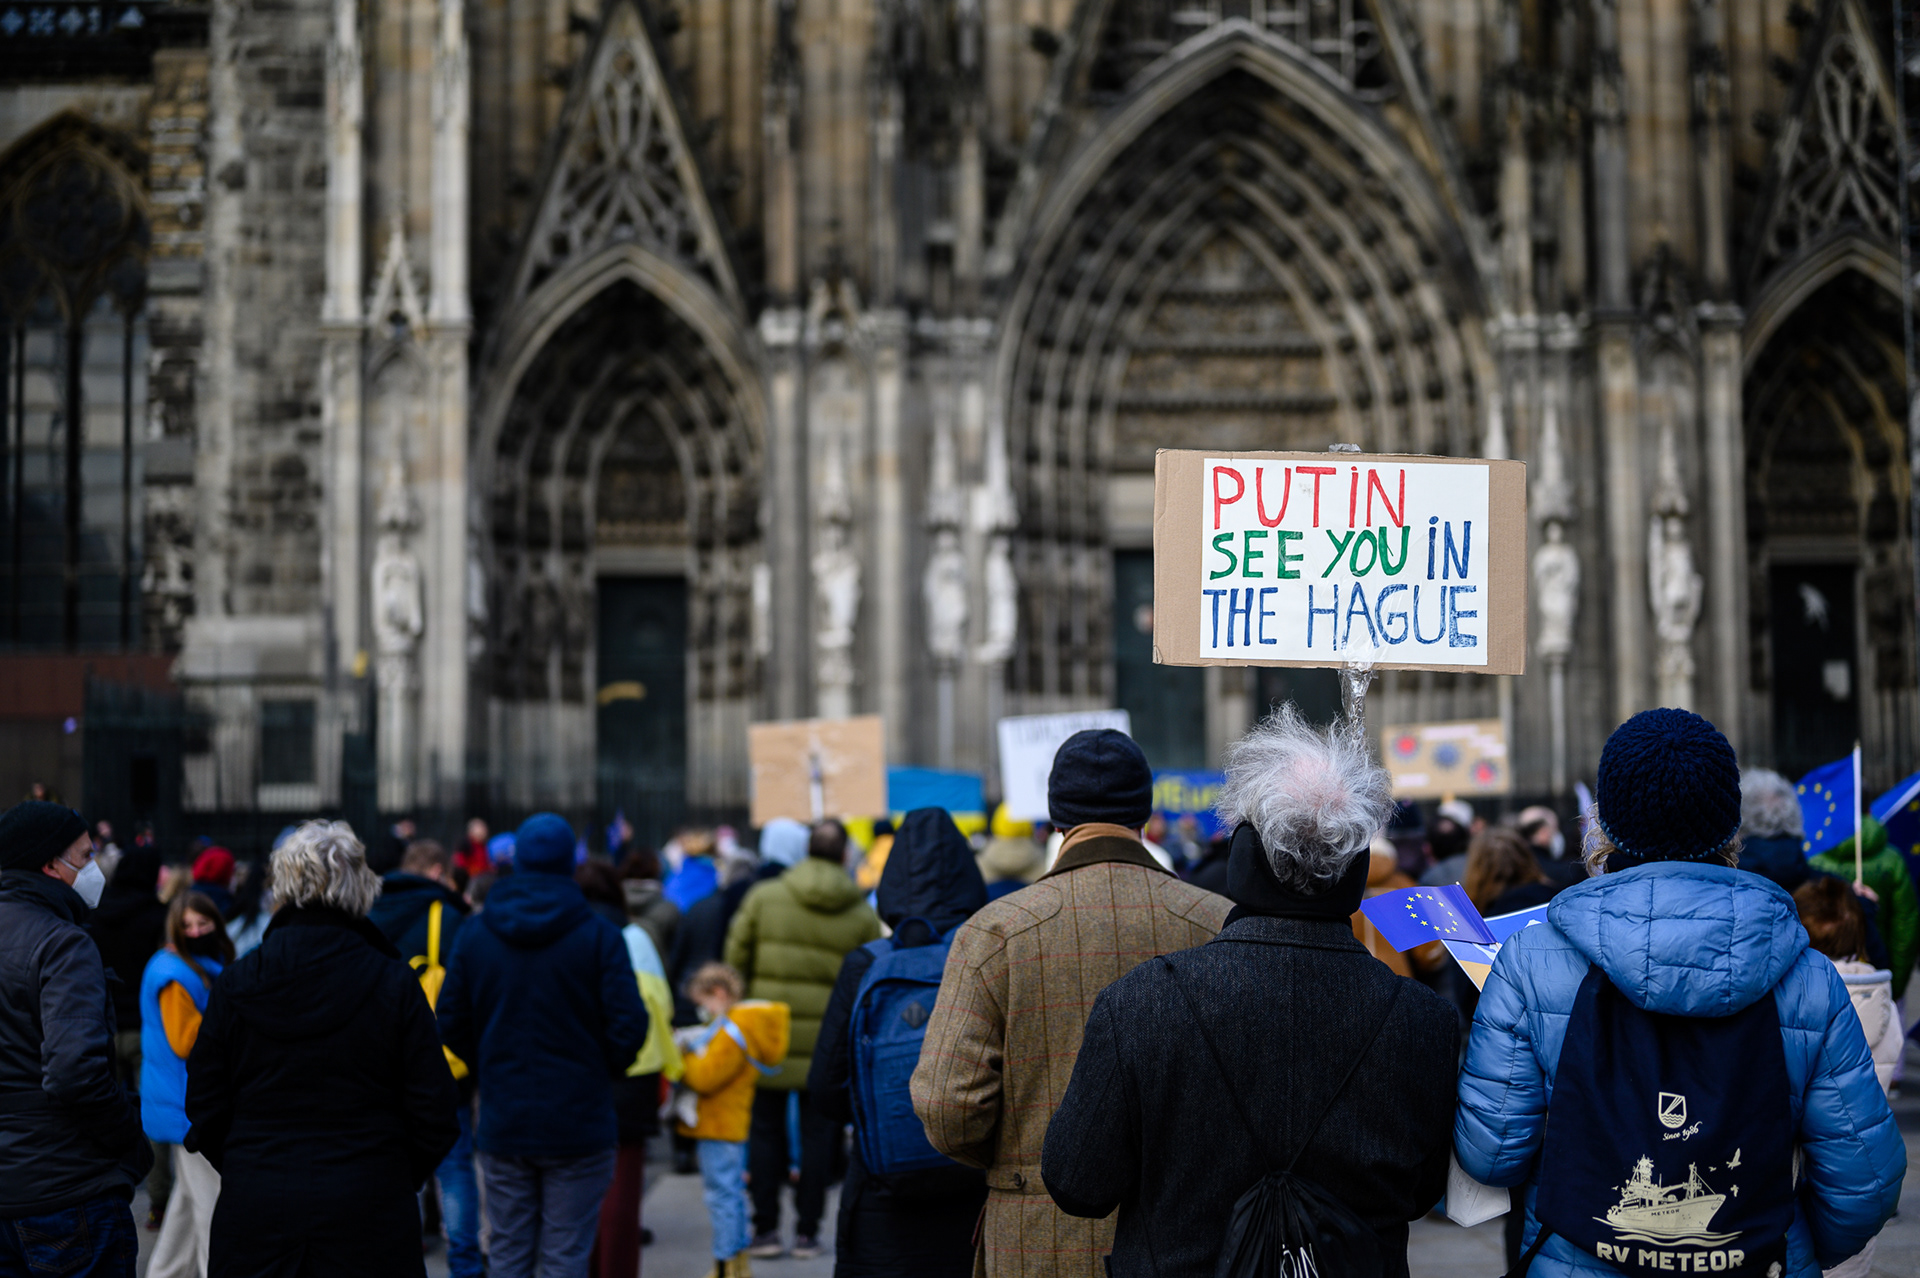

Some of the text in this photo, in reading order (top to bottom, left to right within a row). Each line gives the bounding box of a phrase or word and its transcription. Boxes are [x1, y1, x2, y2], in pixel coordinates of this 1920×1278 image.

[1209, 530, 1304, 580] SEE
[1321, 525, 1412, 579] YOU
[1202, 581, 1478, 651] THE HAGUE
[1662, 1120, 1703, 1142] Since 1986
[1650, 1208, 1680, 1217] METEOR
[1596, 1241, 1745, 1272] RV METEOR
